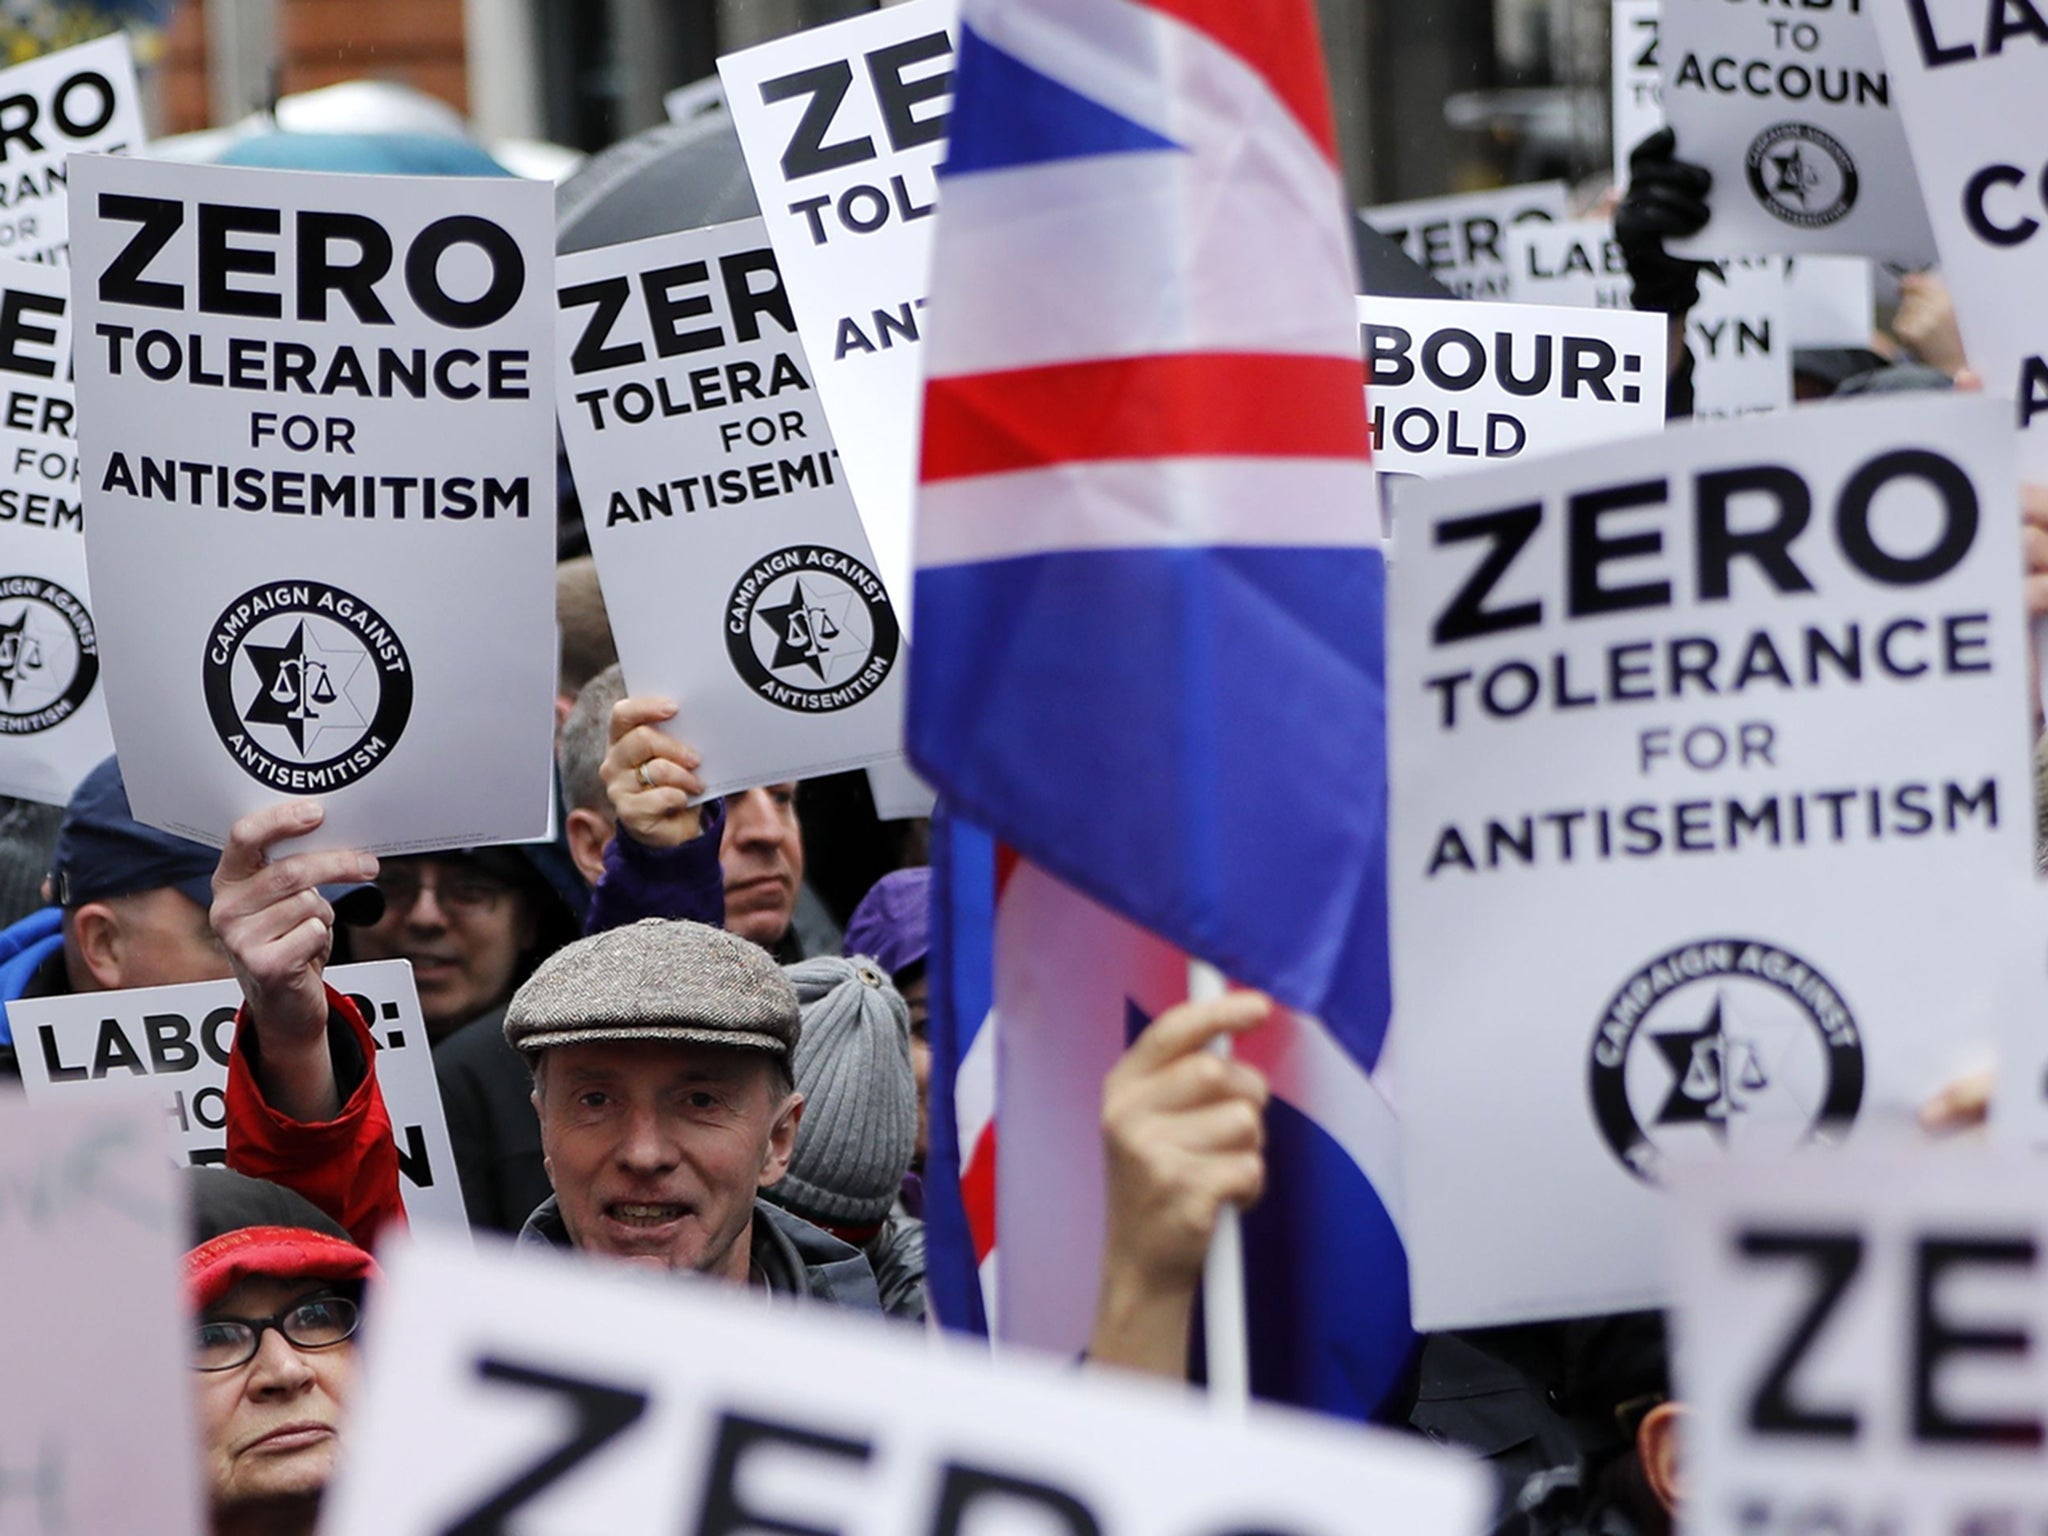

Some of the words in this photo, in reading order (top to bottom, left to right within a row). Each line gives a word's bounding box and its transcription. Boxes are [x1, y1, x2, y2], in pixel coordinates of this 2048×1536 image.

[1769, 19, 1819, 51] TO
[758, 30, 955, 182] ZE
[1676, 52, 1890, 107] ACCOUN
[788, 162, 948, 246] TOL
[1961, 163, 2048, 249] C
[97, 192, 525, 330] ZERO
[0, 288, 74, 382] E
[556, 248, 797, 375] ZER
[834, 298, 930, 361] AN
[95, 323, 530, 400] TOLERANCE
[576, 353, 810, 431] TOLERA
[1359, 323, 1642, 404] BOUR:
[5, 391, 77, 438] ER
[250, 412, 356, 455] FOR
[719, 410, 808, 453] FOR
[102, 451, 530, 520] ANTISEMITISM
[606, 450, 838, 527] ANTISEMI
[1431, 448, 1980, 646] ZERO
[41, 584, 97, 655] AGAINST
[211, 586, 310, 666] CAMPAIGN
[317, 592, 405, 673] AGAINST
[729, 551, 801, 635] CAMPAIGN
[806, 550, 887, 605] AGAINST
[760, 655, 889, 709] ANTISEMITISM
[1426, 612, 1992, 729] TOLERANCE
[228, 734, 387, 789] ANTISEMITISM
[1639, 721, 1777, 774] FOR
[1426, 778, 2000, 878] ANTISEMITISM
[1595, 944, 1733, 1068] CAMPAIGN
[1736, 944, 1857, 1048] AGAINST
[1735, 1232, 2046, 1443] ZE
